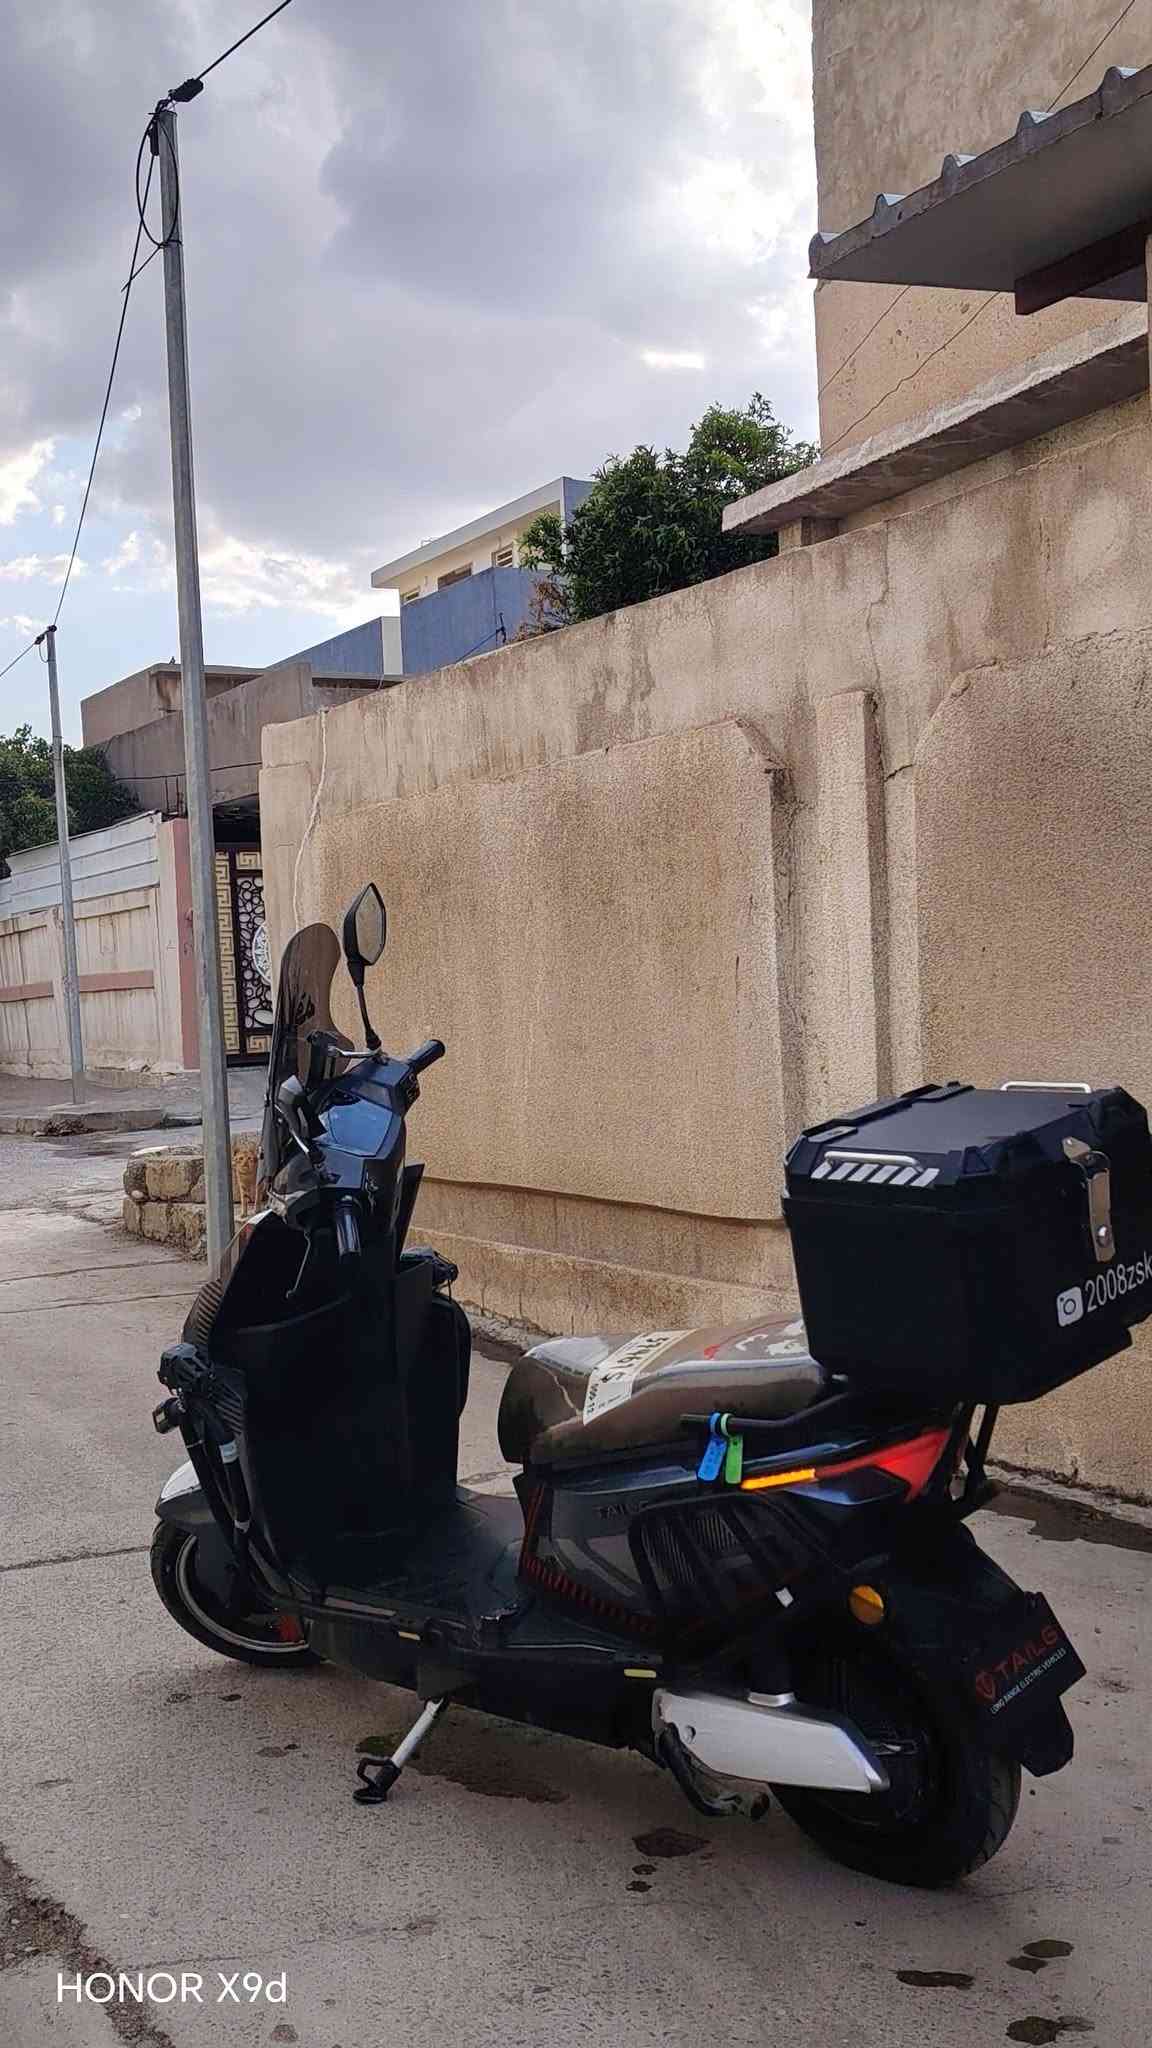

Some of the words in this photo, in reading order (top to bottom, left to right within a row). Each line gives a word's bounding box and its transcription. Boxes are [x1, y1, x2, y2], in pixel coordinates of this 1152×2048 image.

[992, 1623, 1058, 1681] TAILG
[1019, 1665, 1044, 1688] ELECTRIC
[1041, 1647, 1067, 1671] VEHICLES
